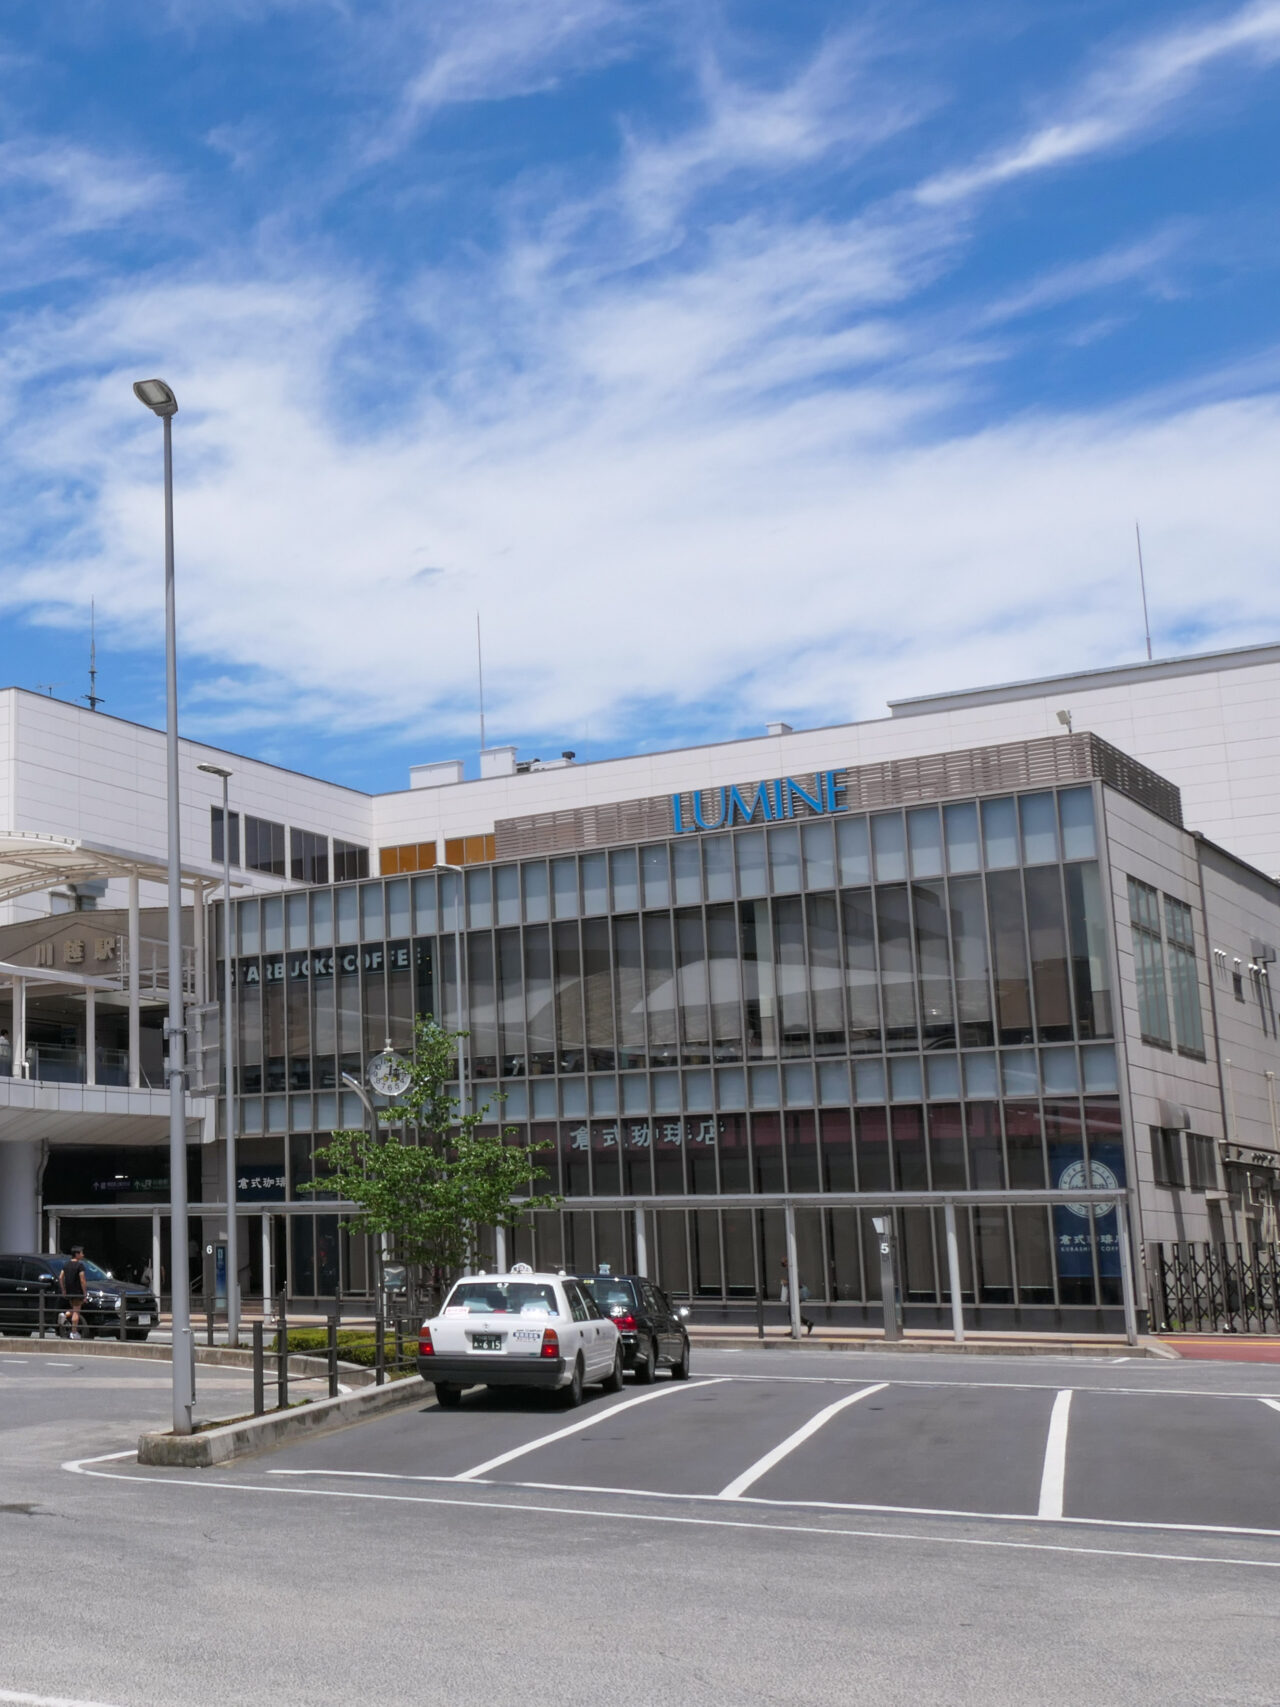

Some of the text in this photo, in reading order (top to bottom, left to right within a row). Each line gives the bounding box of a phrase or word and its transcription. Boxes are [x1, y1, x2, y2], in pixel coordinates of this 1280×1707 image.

[672, 768, 849, 833] LUMINE
[35, 937, 116, 967] 川越駅
[206, 1245, 213, 1254] 6
[881, 1243, 890, 1254] 5
